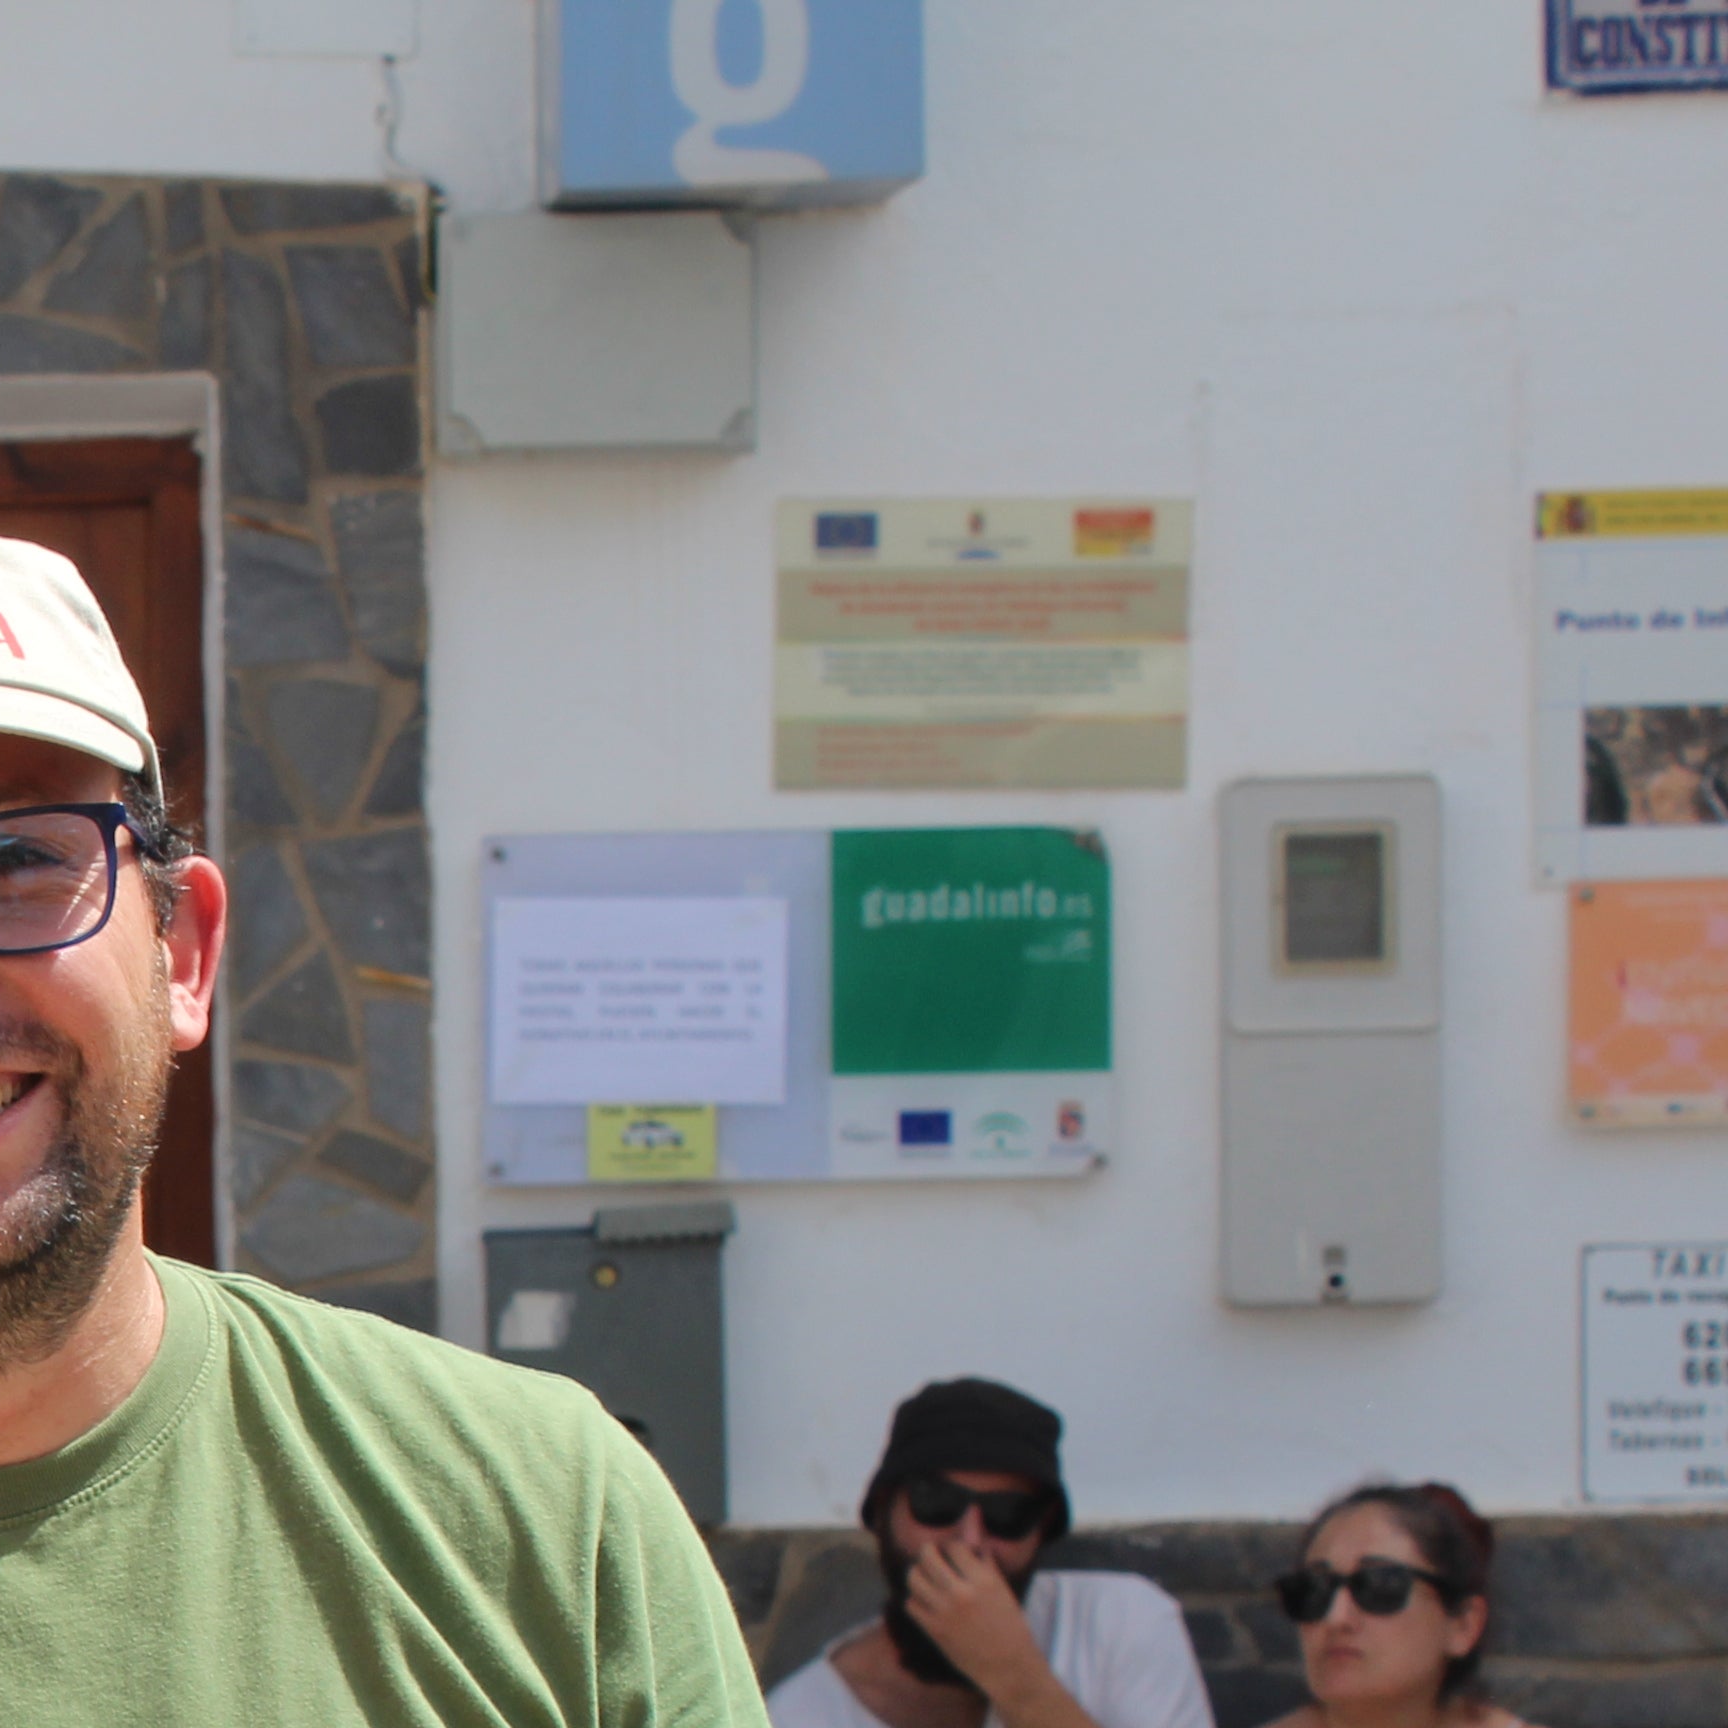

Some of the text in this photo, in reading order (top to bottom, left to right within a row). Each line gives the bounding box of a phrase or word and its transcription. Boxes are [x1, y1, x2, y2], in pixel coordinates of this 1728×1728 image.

[1573, 14, 1728, 68] CONSTI
[1684, 1320, 1728, 1350] 62
[1684, 1356, 1728, 1386] 66
